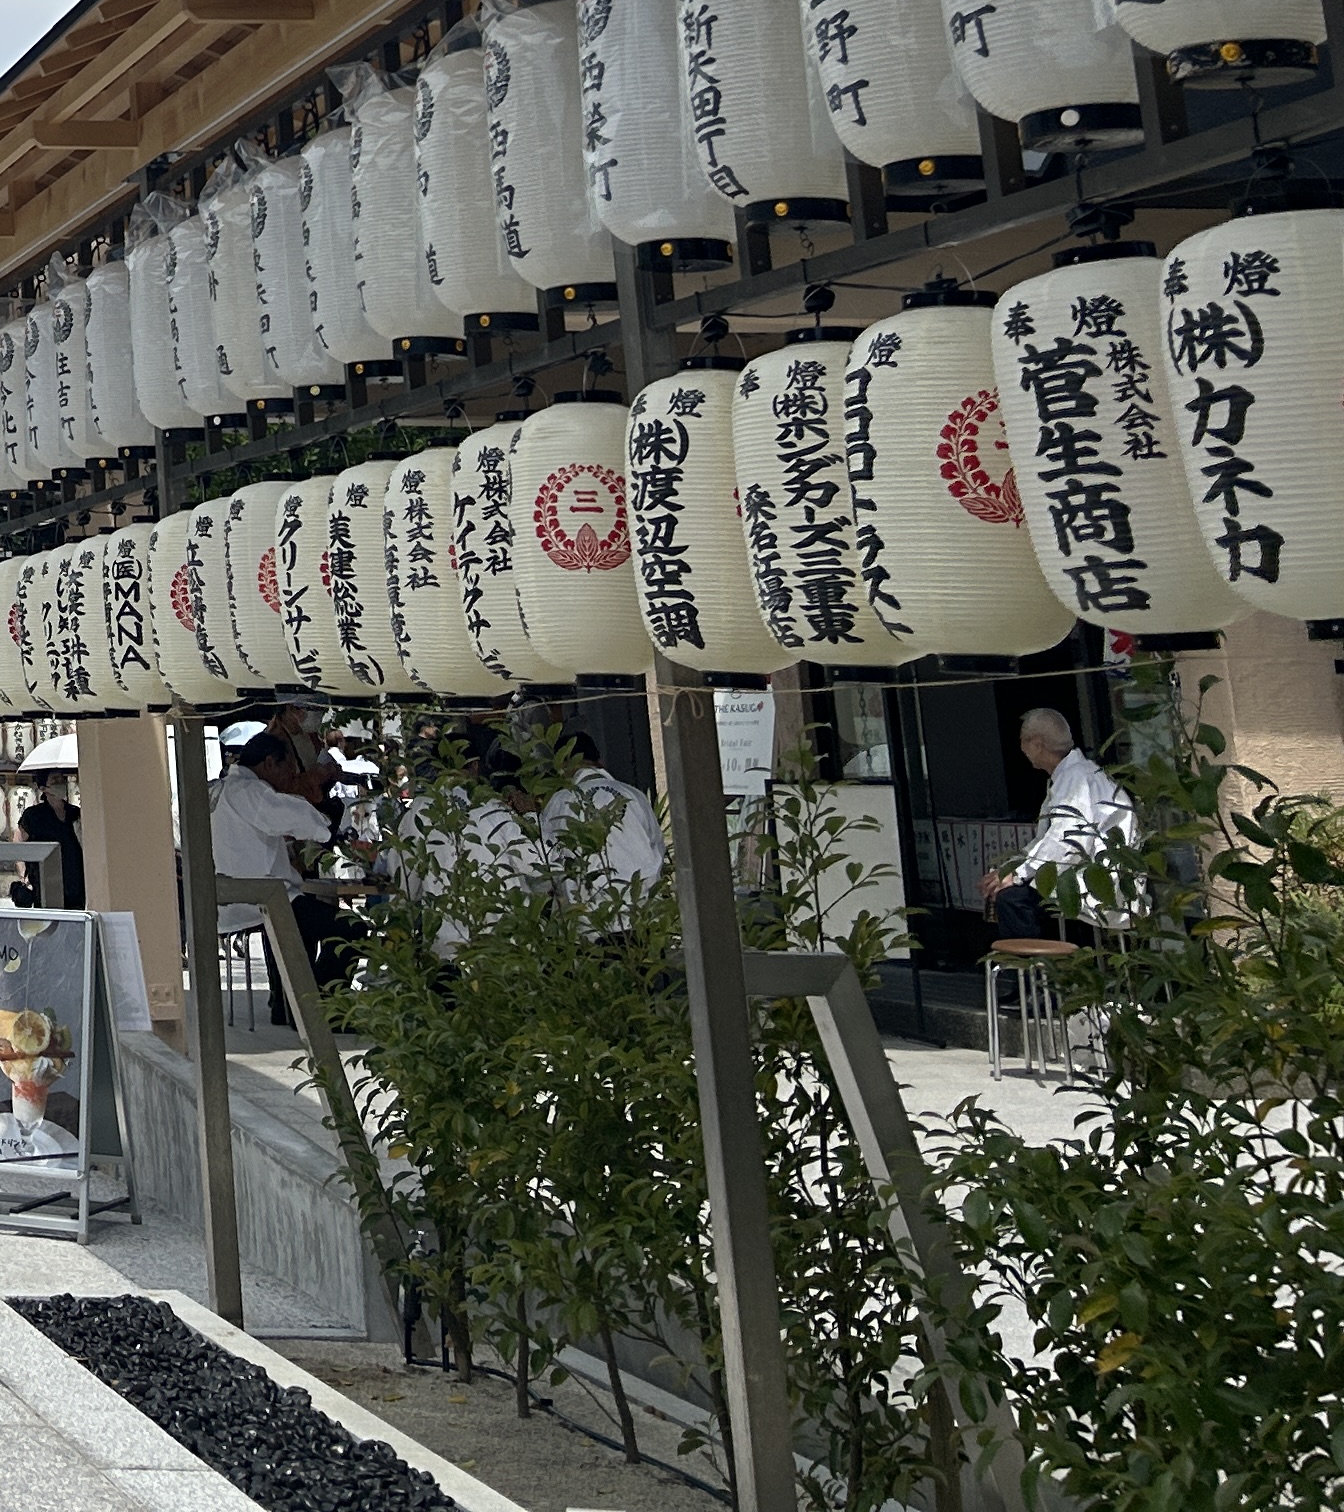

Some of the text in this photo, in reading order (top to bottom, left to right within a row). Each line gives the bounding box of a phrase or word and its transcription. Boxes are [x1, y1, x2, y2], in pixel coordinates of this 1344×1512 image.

[1002, 300, 1037, 346] 奉
[1069, 294, 1127, 339] 燈
[1223, 249, 1282, 298] 燈
[666, 387, 707, 419] 燈
[786, 360, 827, 392] 燈
[1106, 339, 1168, 461] 株式会社
[1017, 336, 1152, 614] 菅生商店
[1167, 297, 1286, 584] (株)カネカ
[402, 496, 441, 592] 株式会社
[476, 475, 512, 577] 株式会社
[568, 489, 605, 514] 三
[629, 417, 706, 651] (株)渡辺空調
[772, 392, 865, 645] (株)ホンダカーズ三重東
[743, 482, 805, 649] 桑名江場店
